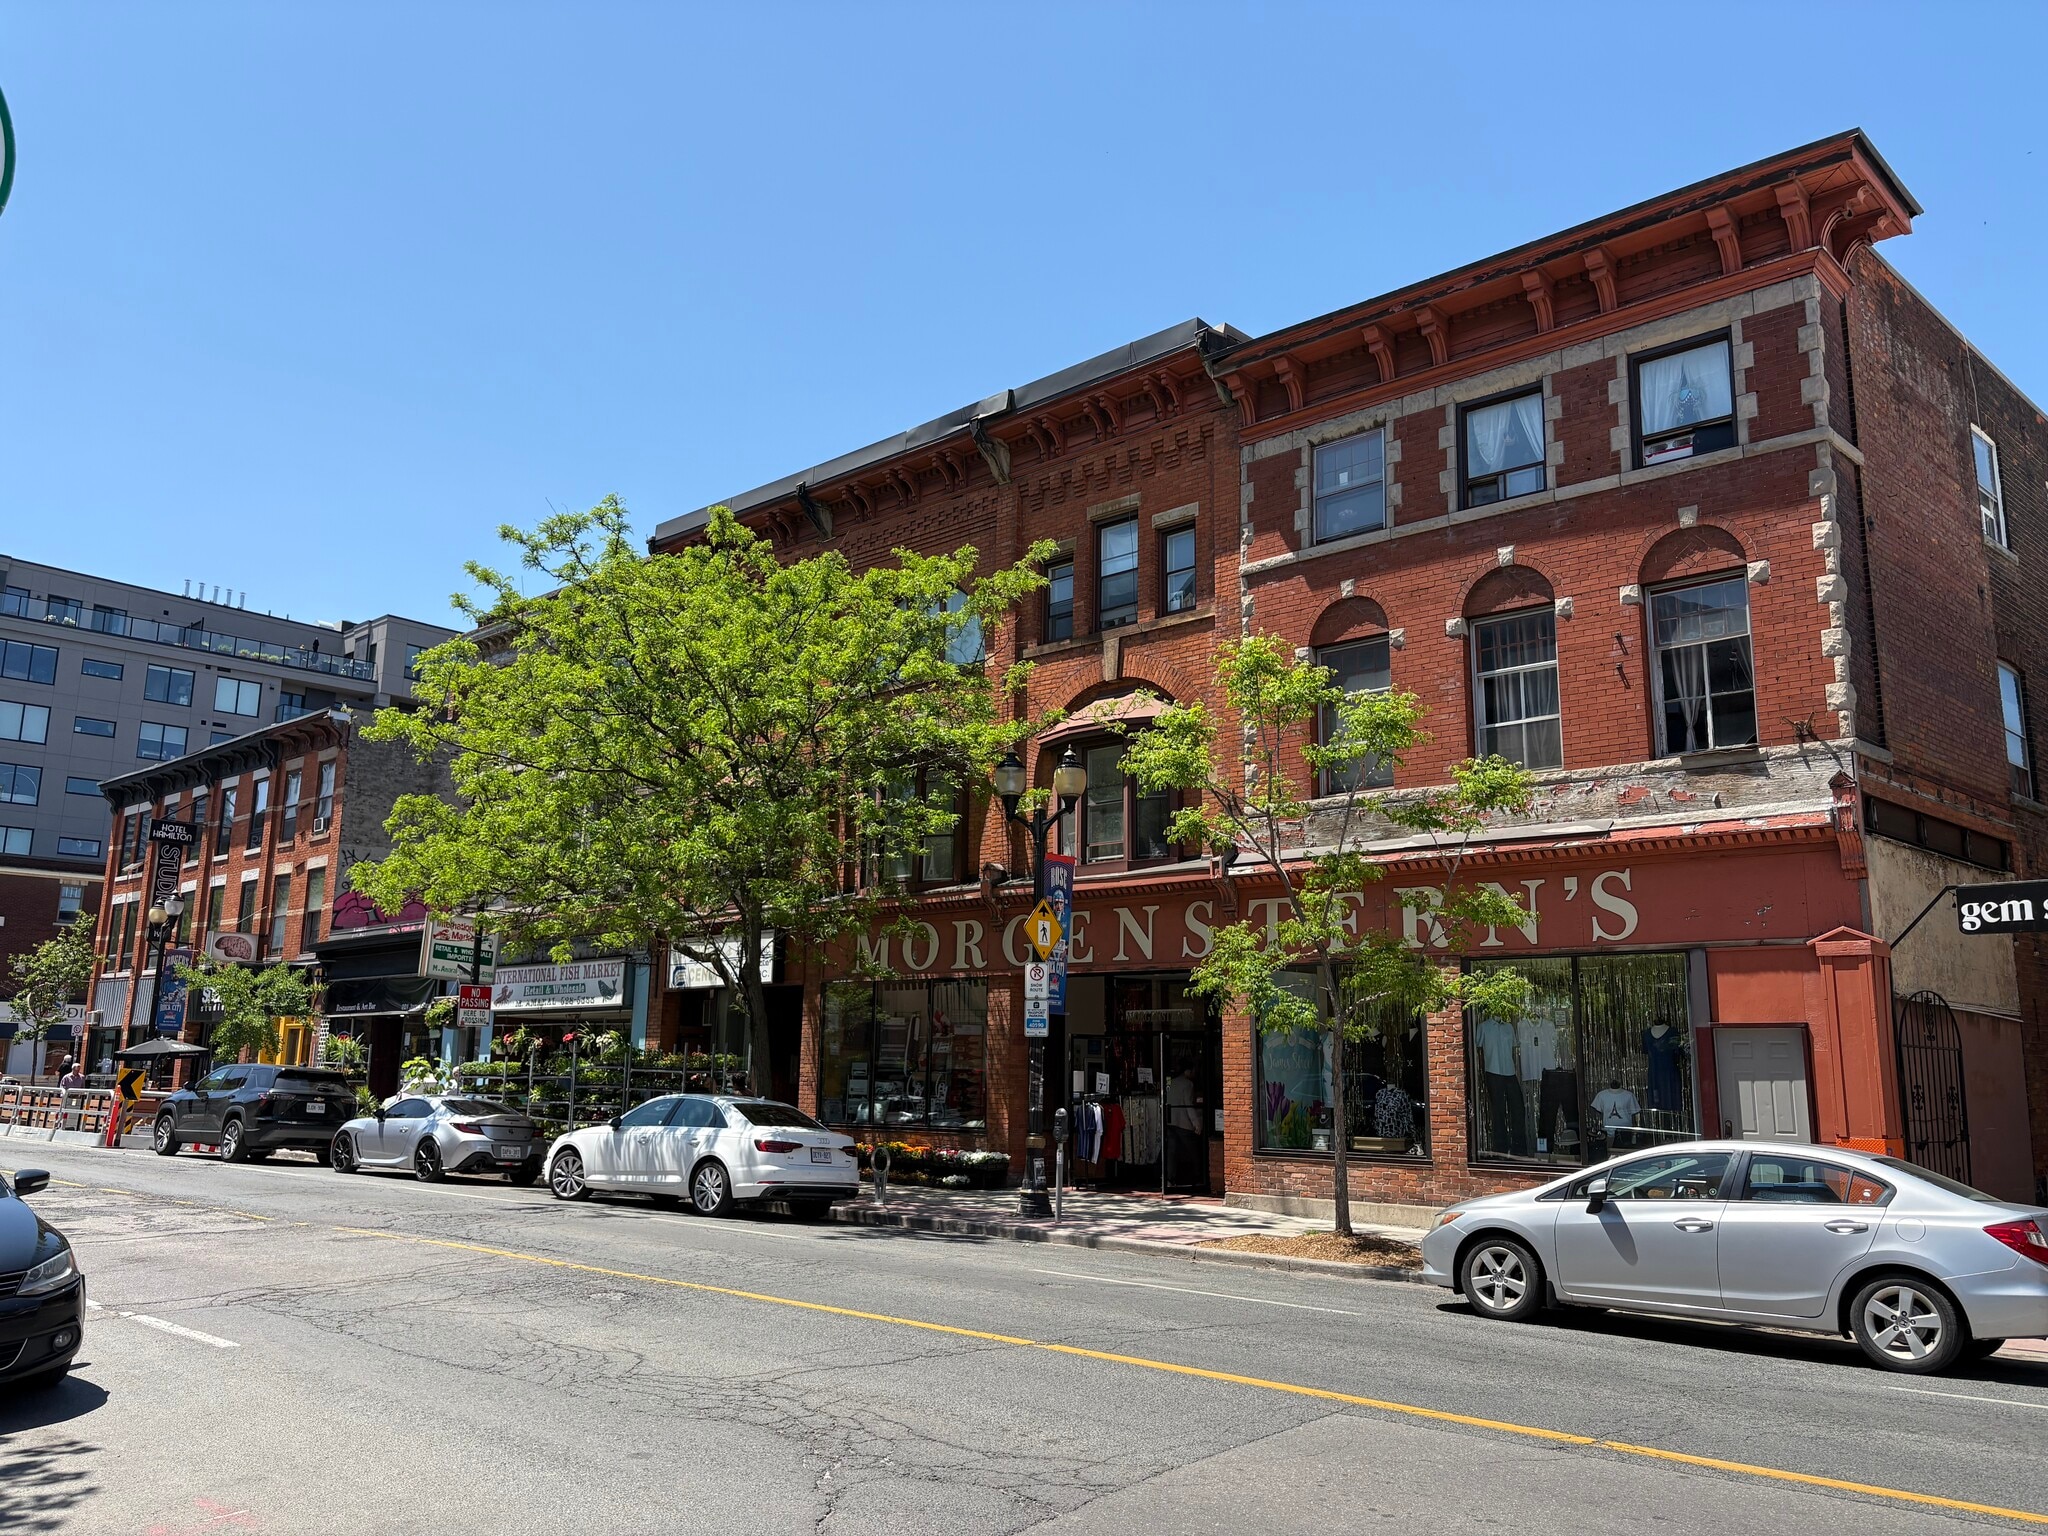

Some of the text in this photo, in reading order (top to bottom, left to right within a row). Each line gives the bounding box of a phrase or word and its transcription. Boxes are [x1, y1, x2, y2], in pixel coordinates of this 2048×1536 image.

[161, 823, 187, 834] HOTEL
[152, 829, 193, 842] HAMILTON
[1050, 866, 1068, 890] ROSE
[1961, 899, 2035, 931] gem
[435, 944, 453, 953] RETAIL
[495, 967, 557, 985] NTERNATIONAL
[559, 965, 580, 981] FISH
[582, 961, 622, 979] MARKET
[471, 988, 481, 998] NO
[525, 983, 585, 996] Retail & Wholesale
[461, 997, 489, 1008] PASSING
